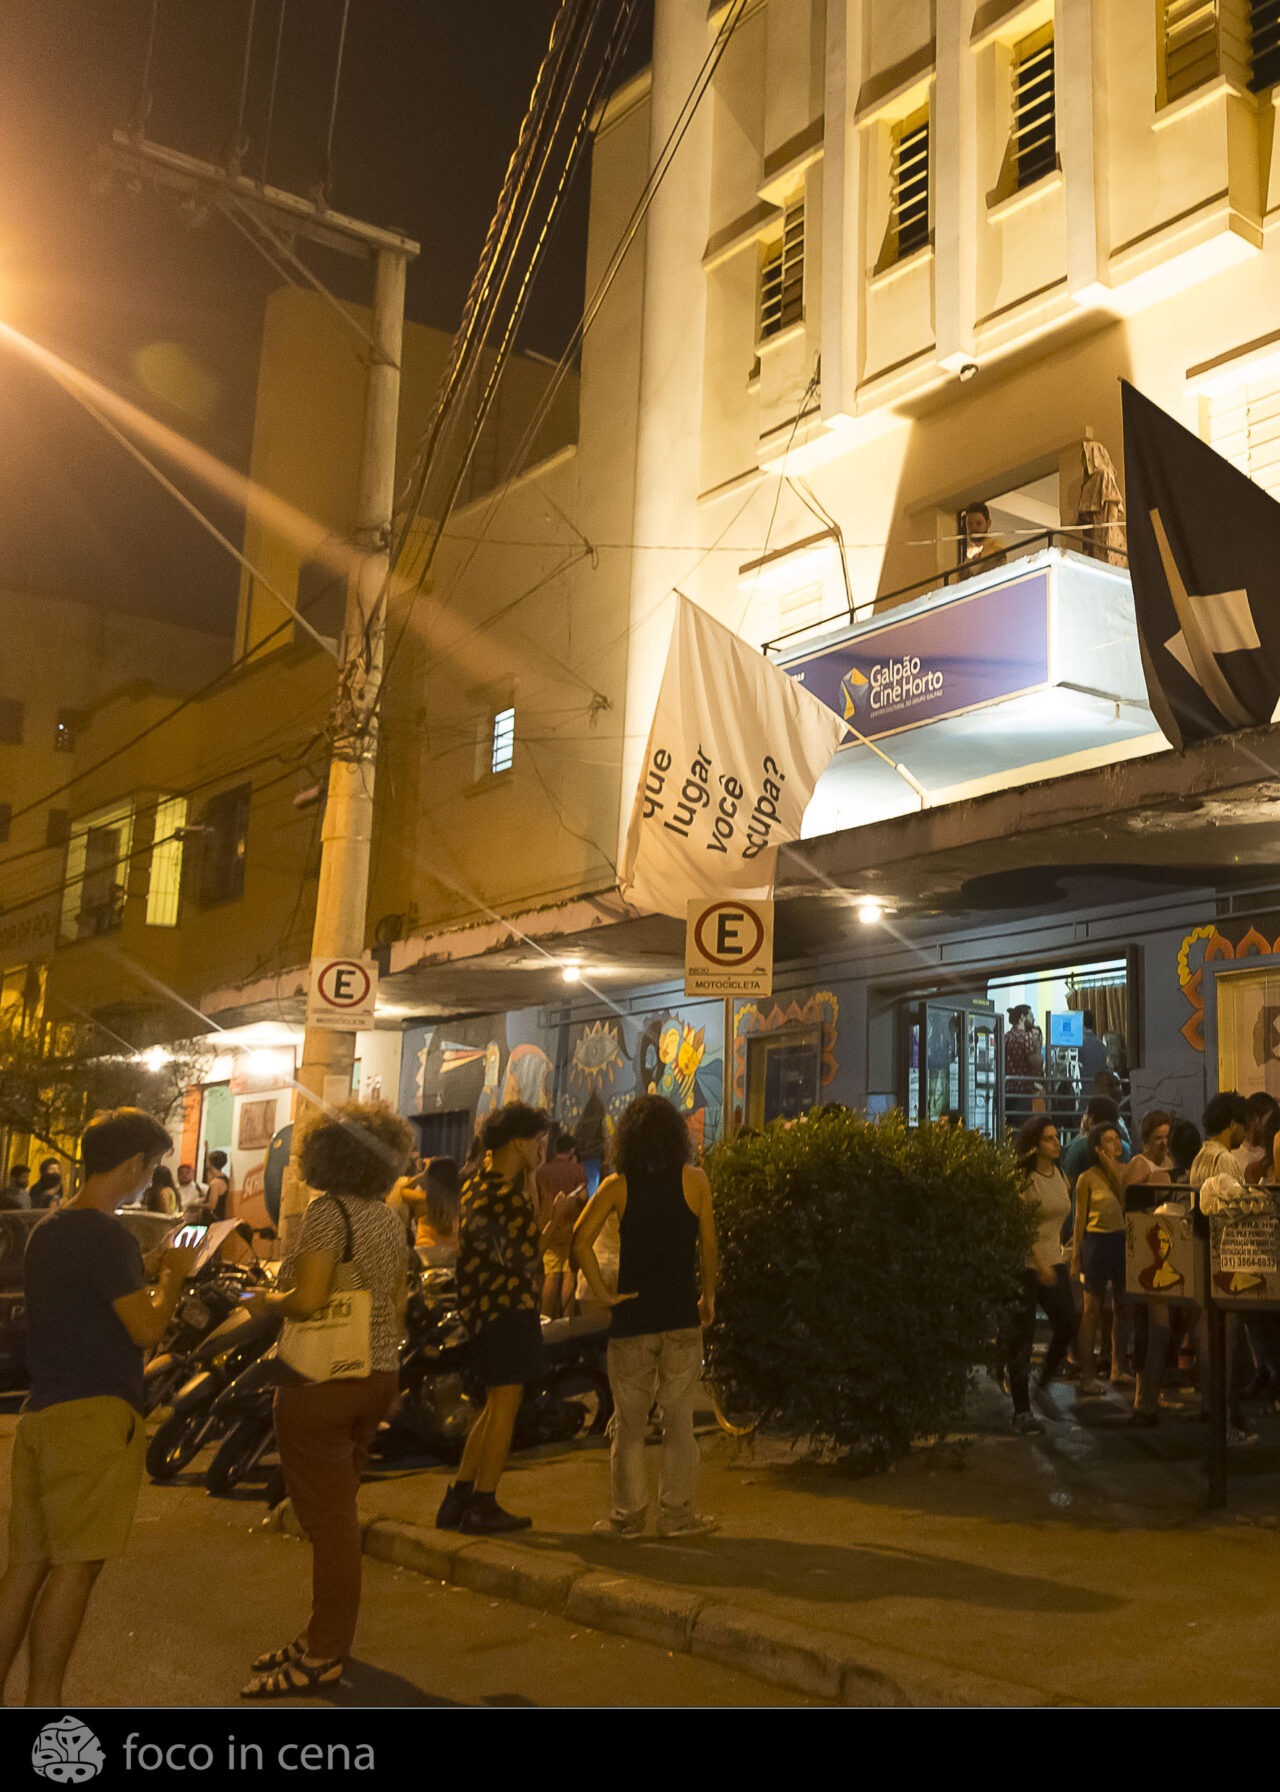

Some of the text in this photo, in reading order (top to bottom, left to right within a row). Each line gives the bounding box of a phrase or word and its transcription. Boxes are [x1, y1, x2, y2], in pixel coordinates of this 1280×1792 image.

[870, 655, 921, 688] Galpão
[663, 743, 712, 838] lugar
[742, 755, 785, 859] ocupa?
[706, 774, 744, 854] você
[717, 913, 744, 954] E
[334, 969, 356, 999] E
[695, 980, 760, 989] MOTOCICLETA
